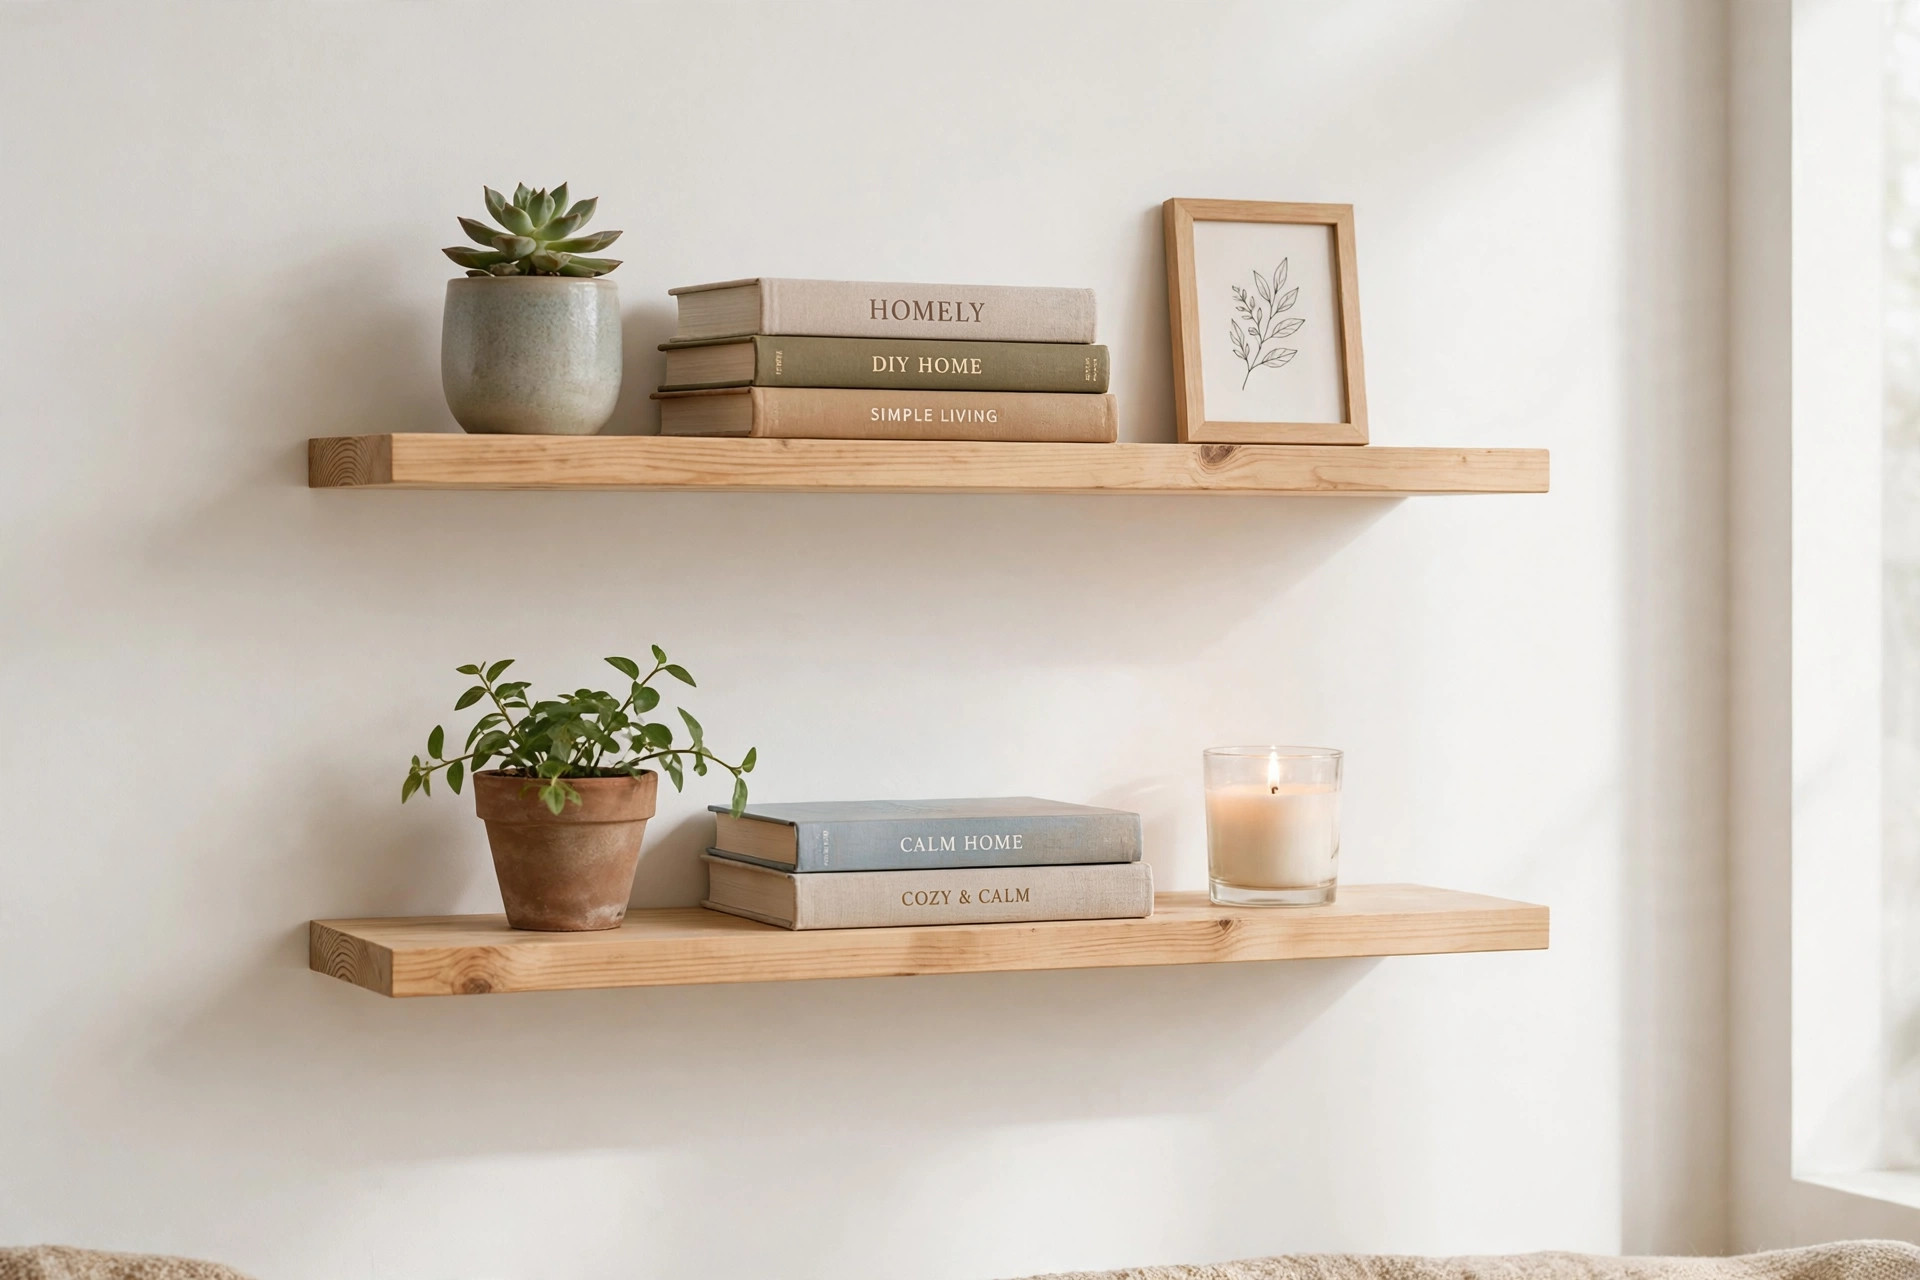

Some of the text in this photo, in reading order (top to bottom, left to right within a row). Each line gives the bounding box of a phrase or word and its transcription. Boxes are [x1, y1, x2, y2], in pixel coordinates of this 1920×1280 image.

[870, 299, 986, 324] HOMELY
[872, 355, 983, 375] DIY HOME
[870, 407, 998, 424] SIMPLE LIVING
[900, 834, 1024, 853] CALM HOME
[901, 888, 1031, 907] COZY & CALM
